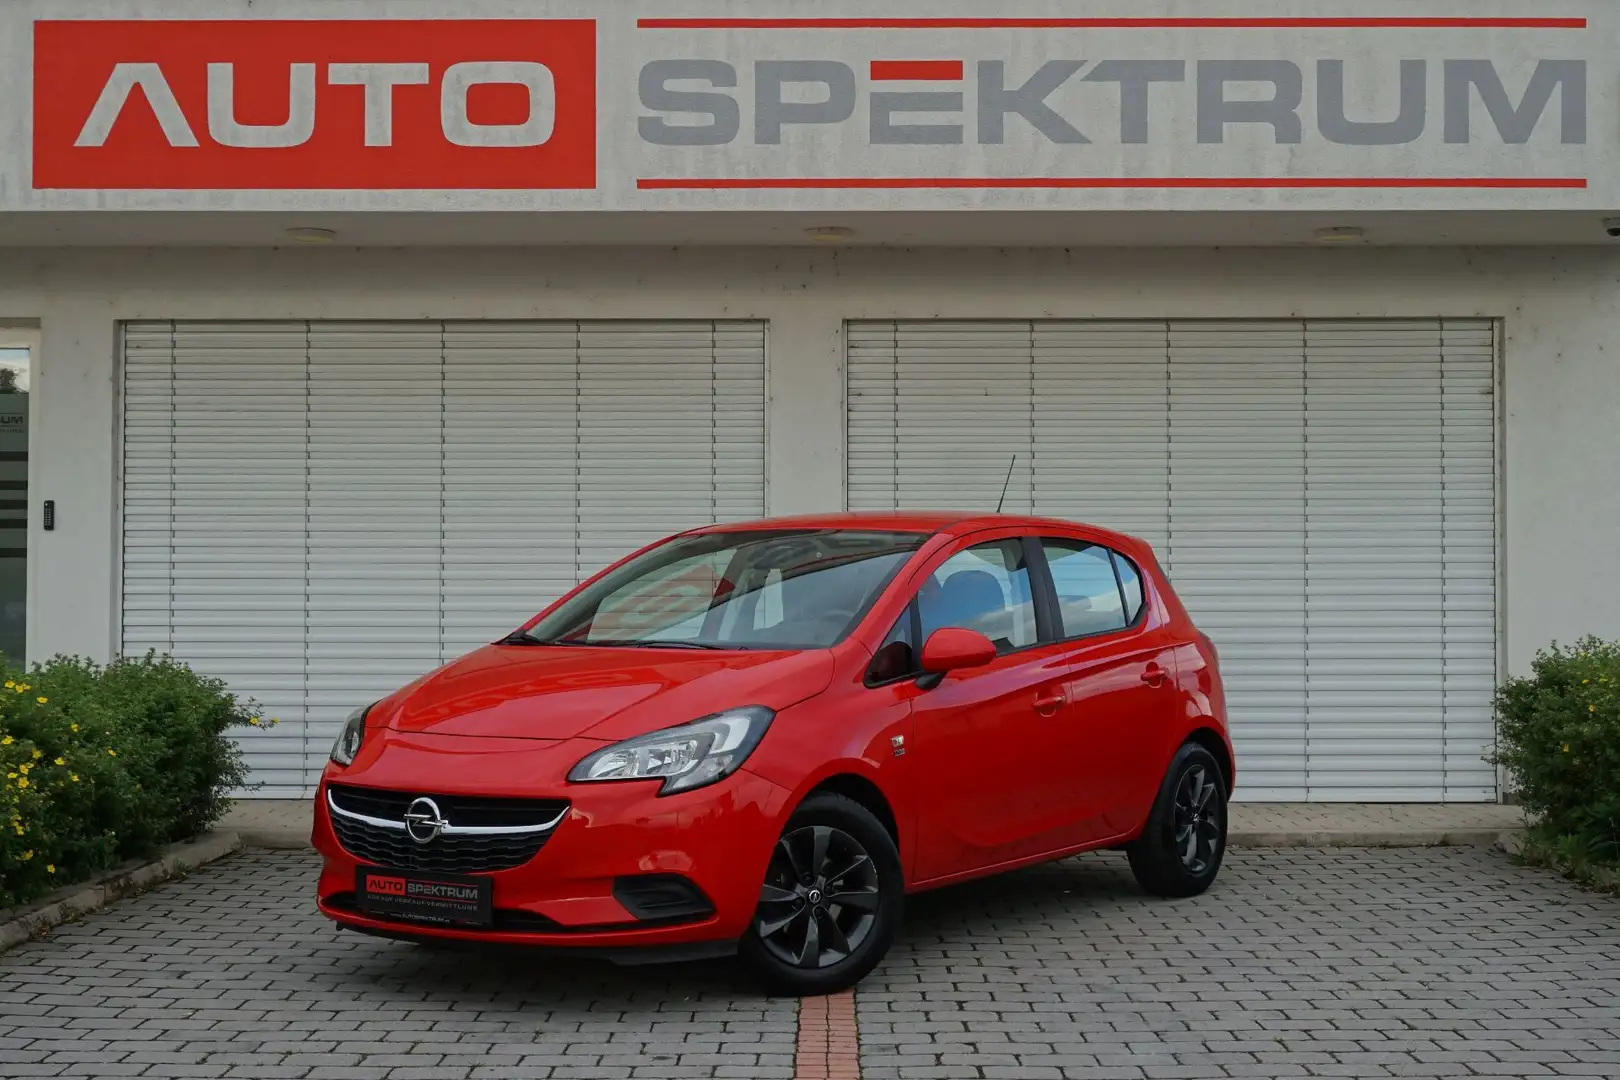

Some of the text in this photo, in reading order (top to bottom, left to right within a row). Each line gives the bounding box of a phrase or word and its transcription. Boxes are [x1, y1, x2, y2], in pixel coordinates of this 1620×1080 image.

[73, 58, 1586, 149] AUTO SPEKTRUM
[368, 879, 478, 899] AUTO SPEKTRUM
